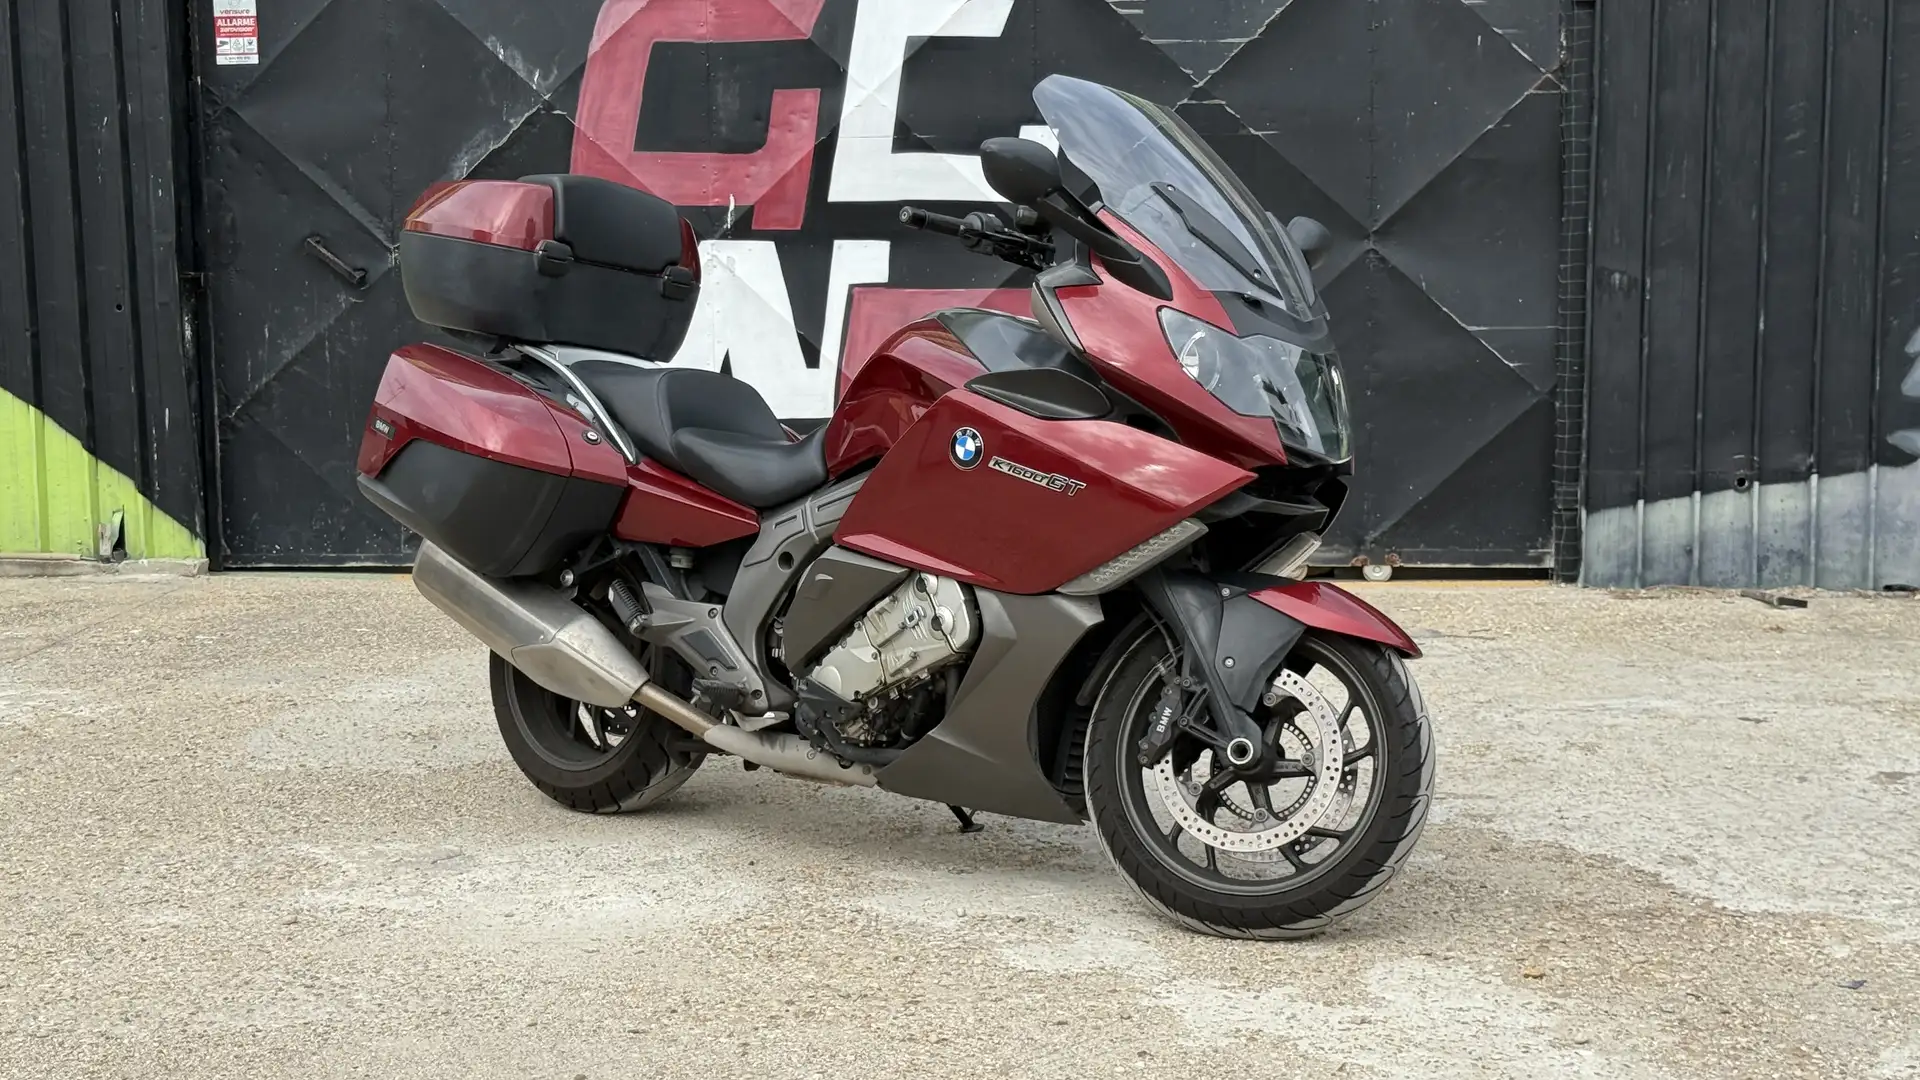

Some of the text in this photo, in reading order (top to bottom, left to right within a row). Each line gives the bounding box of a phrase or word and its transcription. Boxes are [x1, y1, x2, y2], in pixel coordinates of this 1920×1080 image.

[216, 18, 256, 27] ALLARME
[375, 420, 390, 434] BMW
[1156, 706, 1173, 733] BMW
